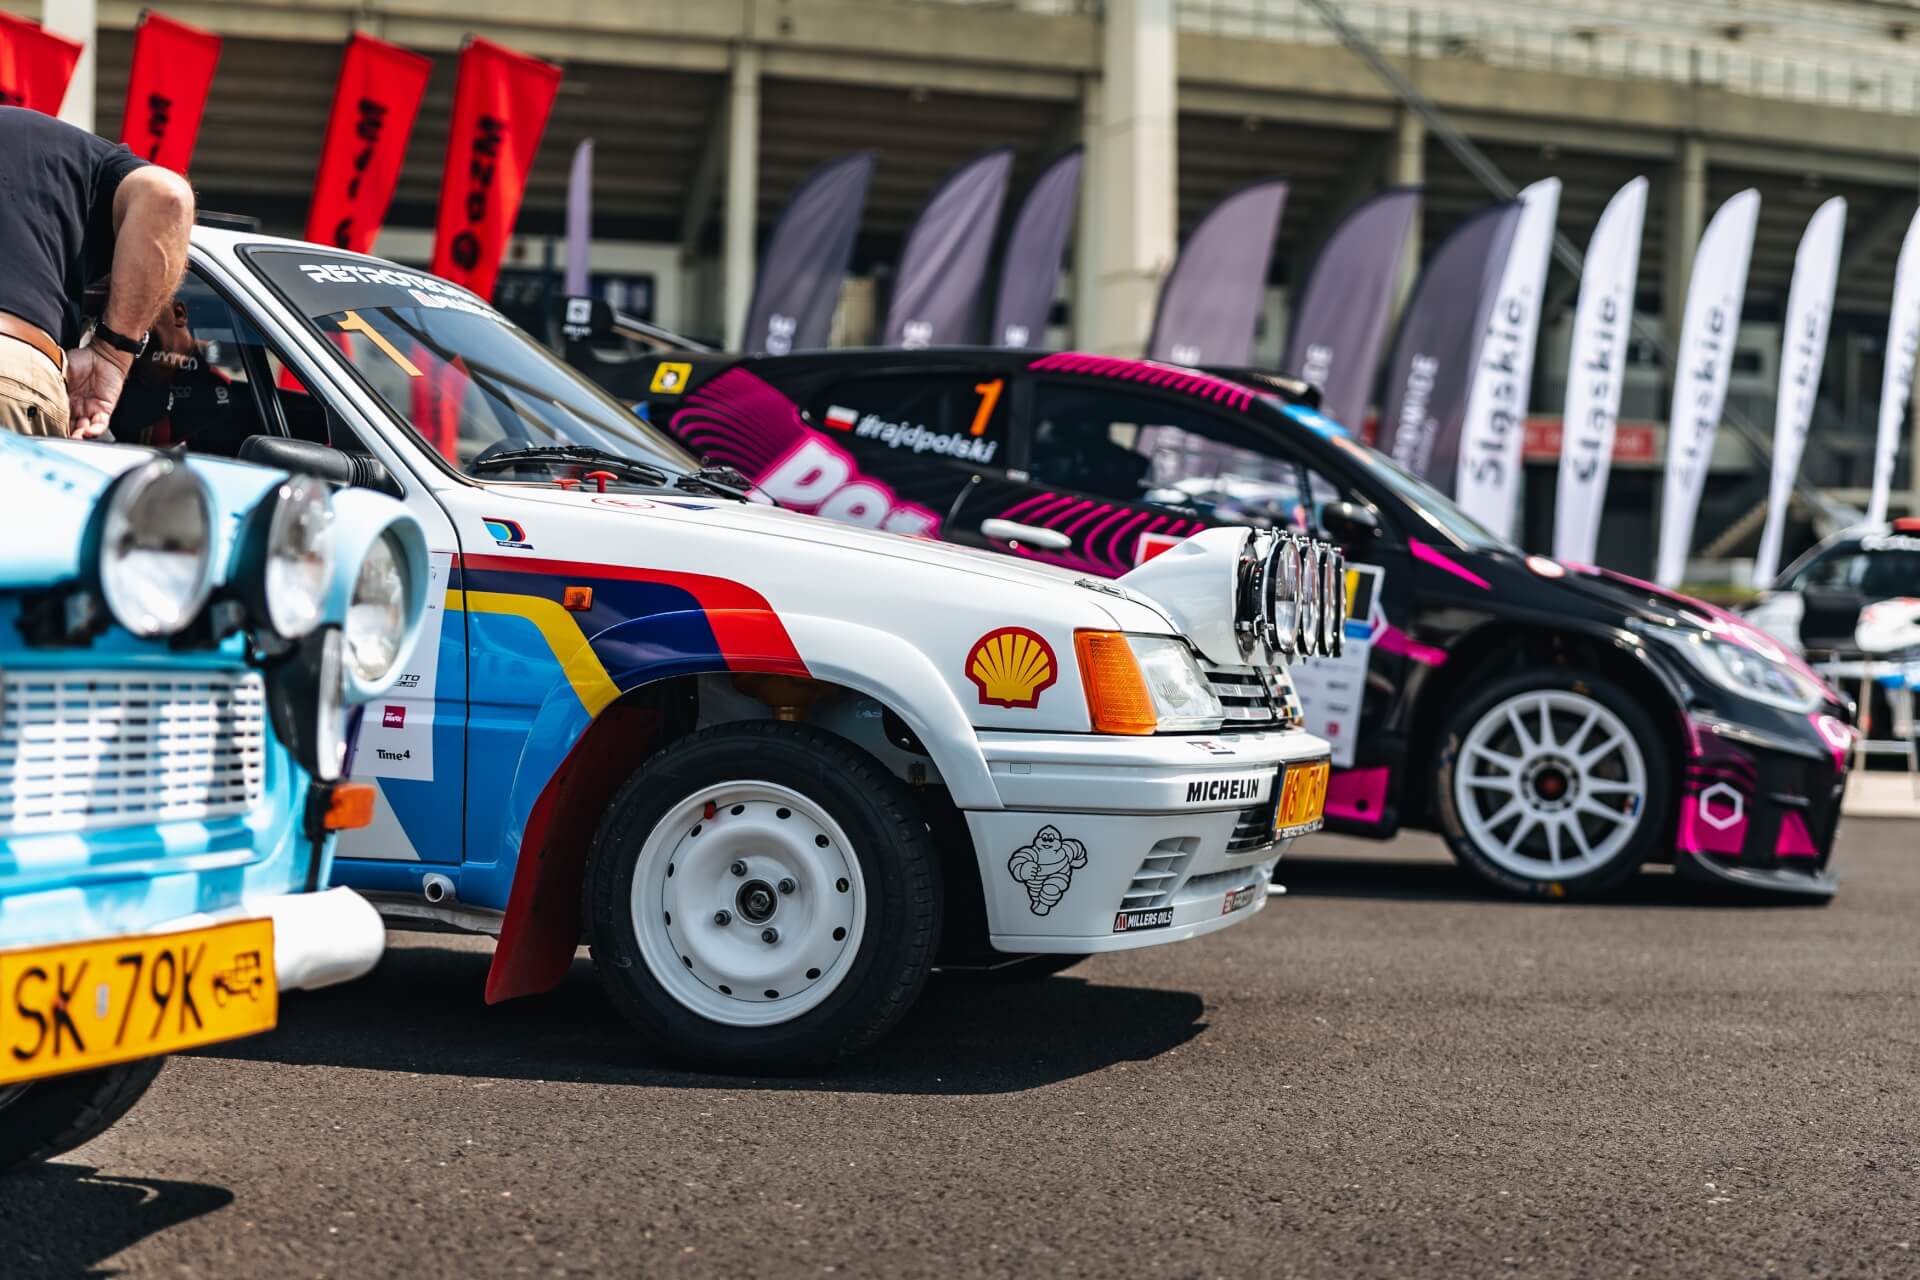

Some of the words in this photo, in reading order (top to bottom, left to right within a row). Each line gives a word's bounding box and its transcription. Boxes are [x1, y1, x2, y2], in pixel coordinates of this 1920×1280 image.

[337, 310, 424, 377] 1
[970, 378, 1004, 436] 1
[856, 413, 999, 464] #rajdpolski
[376, 749, 411, 761] Time4
[1186, 778, 1260, 802] MICHELIN
[1127, 912, 1157, 928] MILLERS
[1158, 911, 1172, 924] OILS
[12, 958, 89, 1063] SK
[114, 942, 207, 1047] 79K
